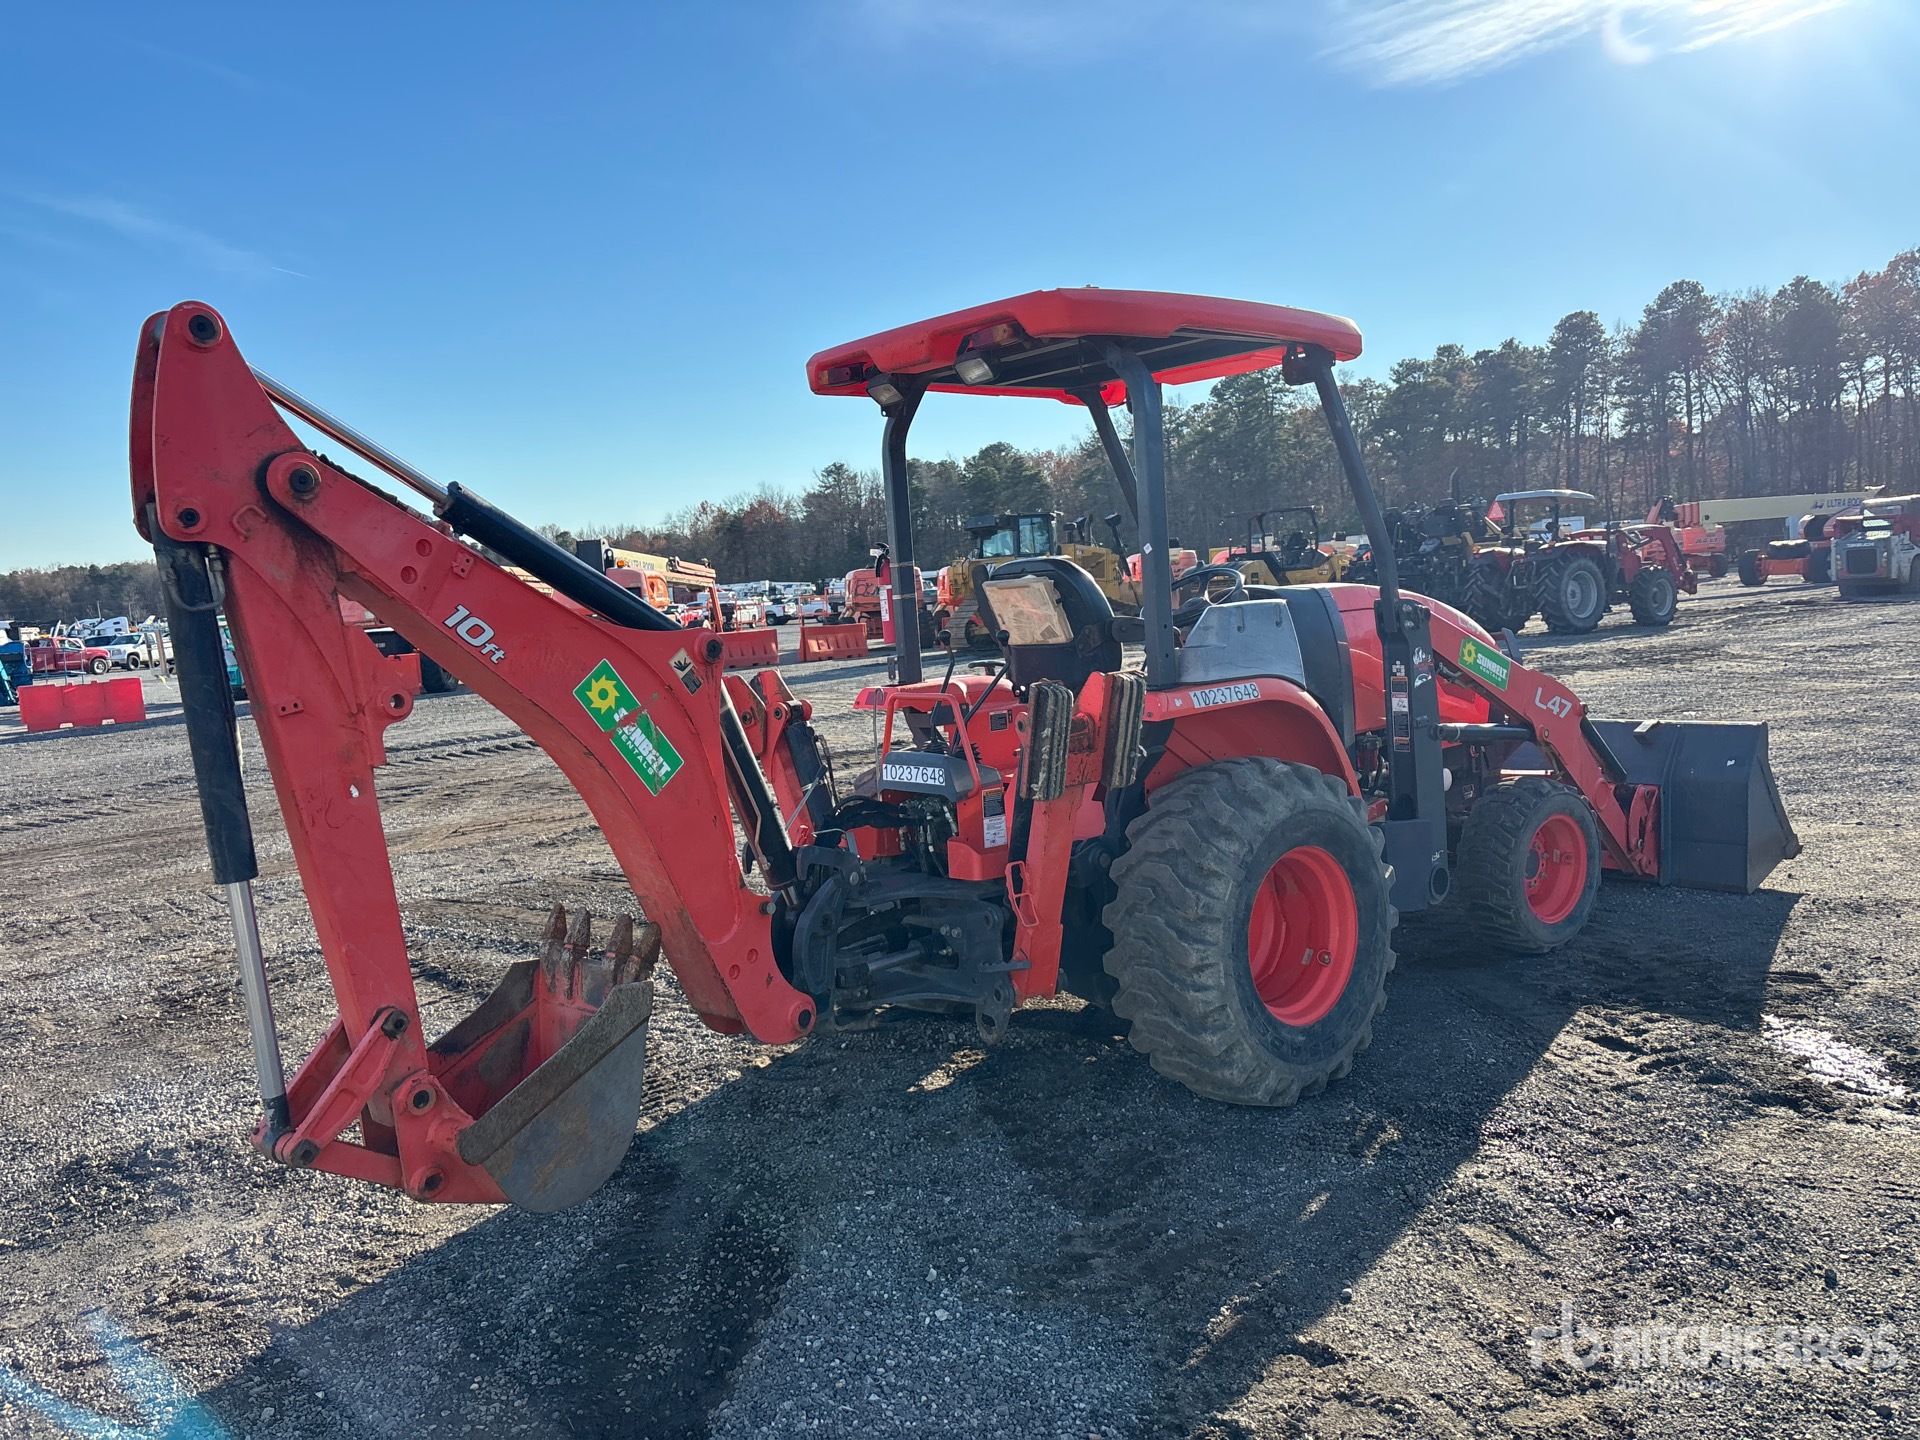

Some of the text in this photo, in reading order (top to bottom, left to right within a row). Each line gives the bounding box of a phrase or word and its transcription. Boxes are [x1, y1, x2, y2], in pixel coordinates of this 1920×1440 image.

[1827, 498, 1845, 508] ULTRA
[1847, 497, 1862, 507] BOO
[1476, 652, 1508, 680] SUNBELT
[1192, 682, 1260, 707] 10237648
[1534, 686, 1573, 719] L47
[616, 726, 655, 776] RENTALS
[883, 765, 946, 785] 10237648
